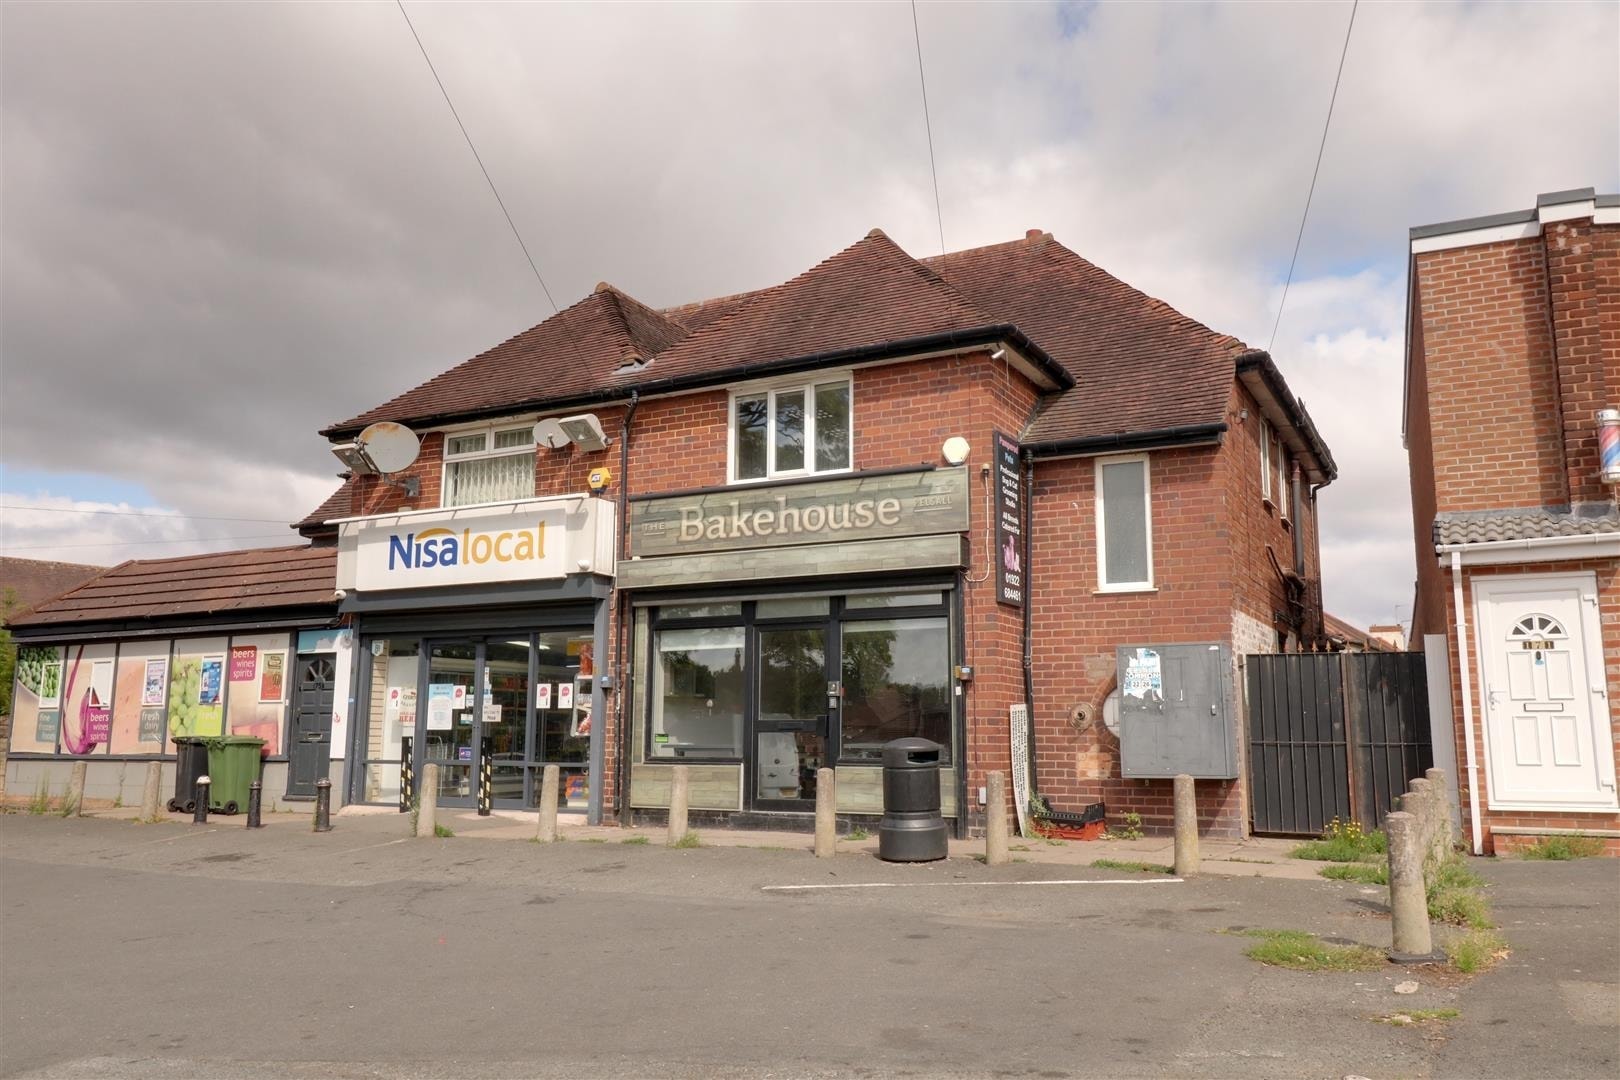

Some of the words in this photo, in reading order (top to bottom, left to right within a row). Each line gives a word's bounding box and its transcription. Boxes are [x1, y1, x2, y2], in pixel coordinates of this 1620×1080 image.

[678, 495, 901, 542] Bakehouse
[233, 649, 255, 659] beers
[236, 660, 255, 668] wines
[233, 669, 253, 680] spirits
[90, 712, 109, 722] beers
[142, 711, 160, 720] fresh
